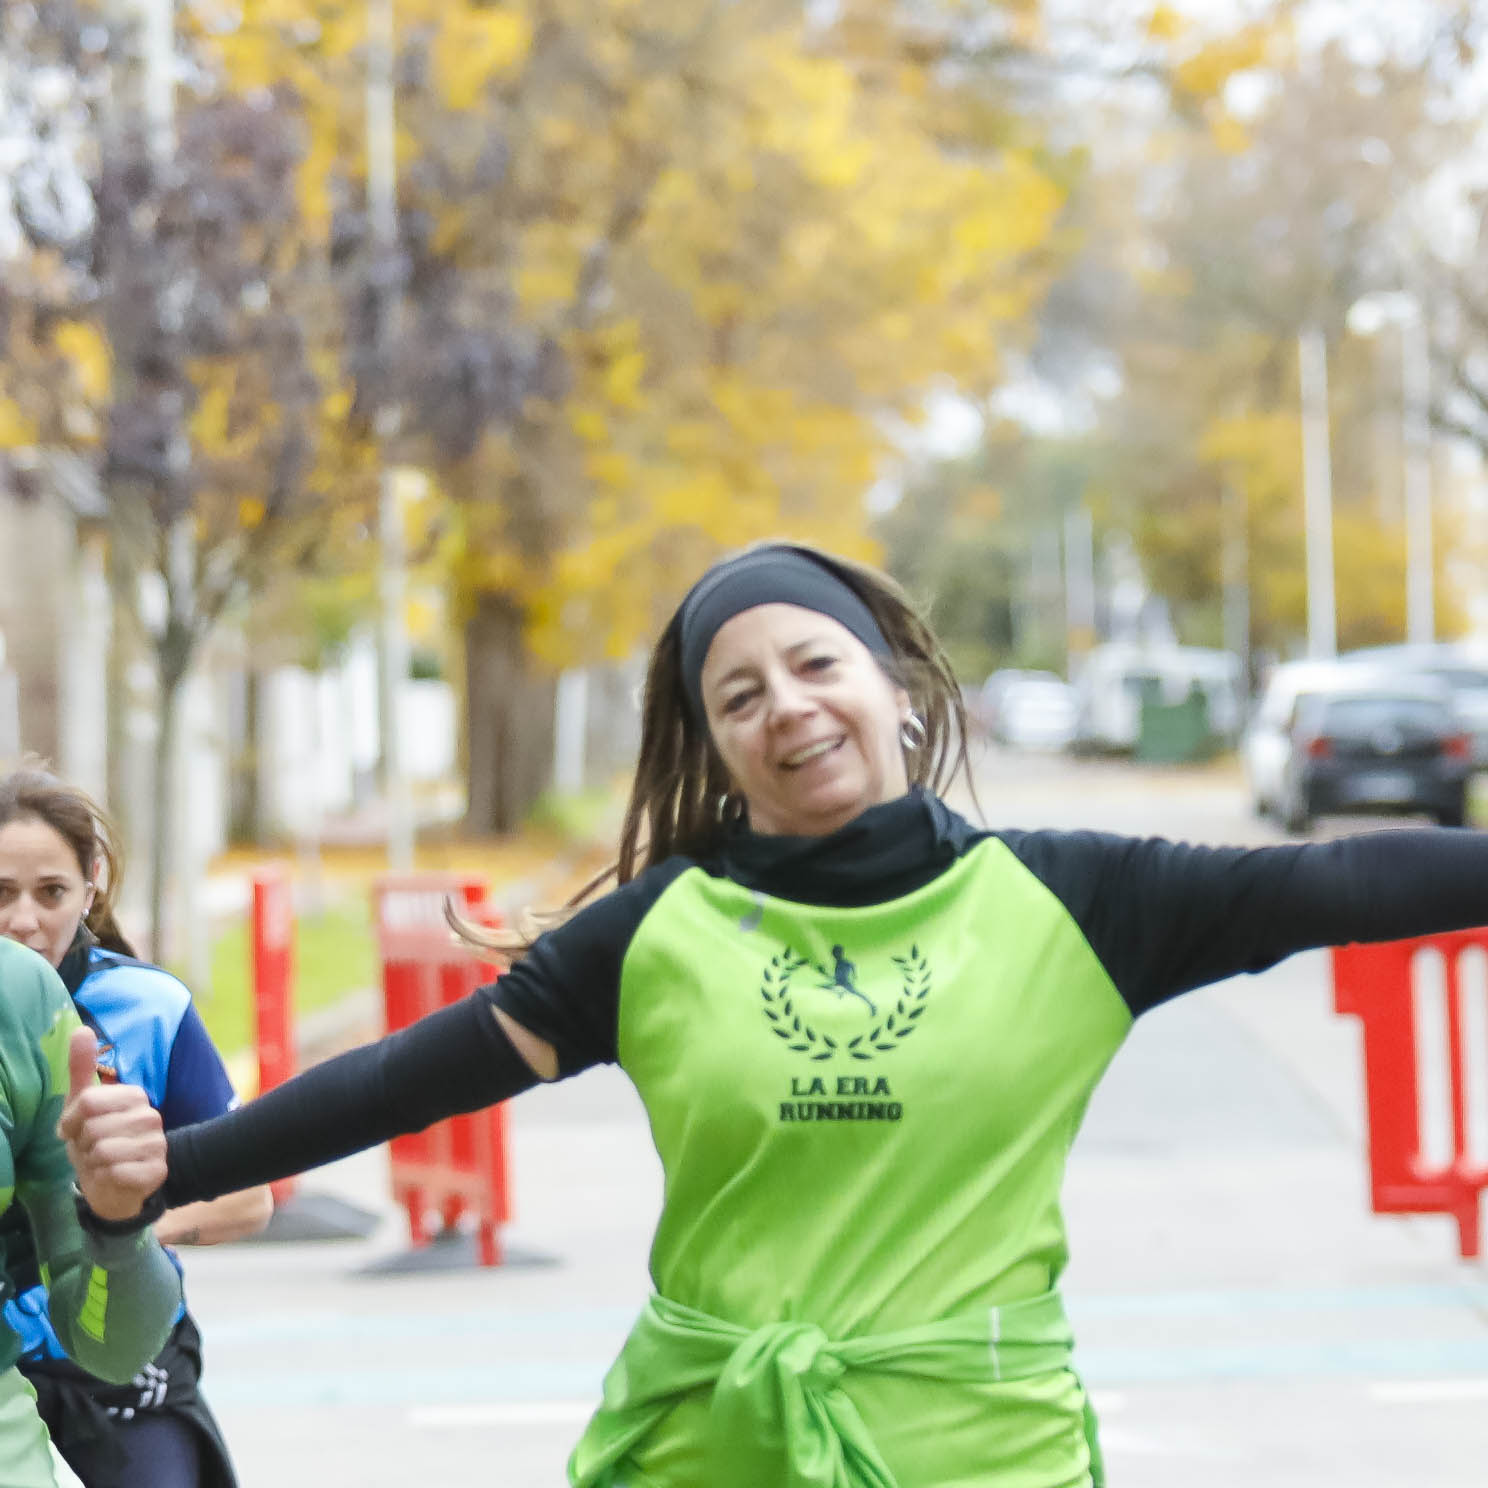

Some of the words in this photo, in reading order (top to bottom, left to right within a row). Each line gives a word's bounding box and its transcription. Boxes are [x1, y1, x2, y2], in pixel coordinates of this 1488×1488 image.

[791, 1077, 827, 1096] LA
[836, 1077, 891, 1097] ERA
[779, 1102, 904, 1121] RUNNING
